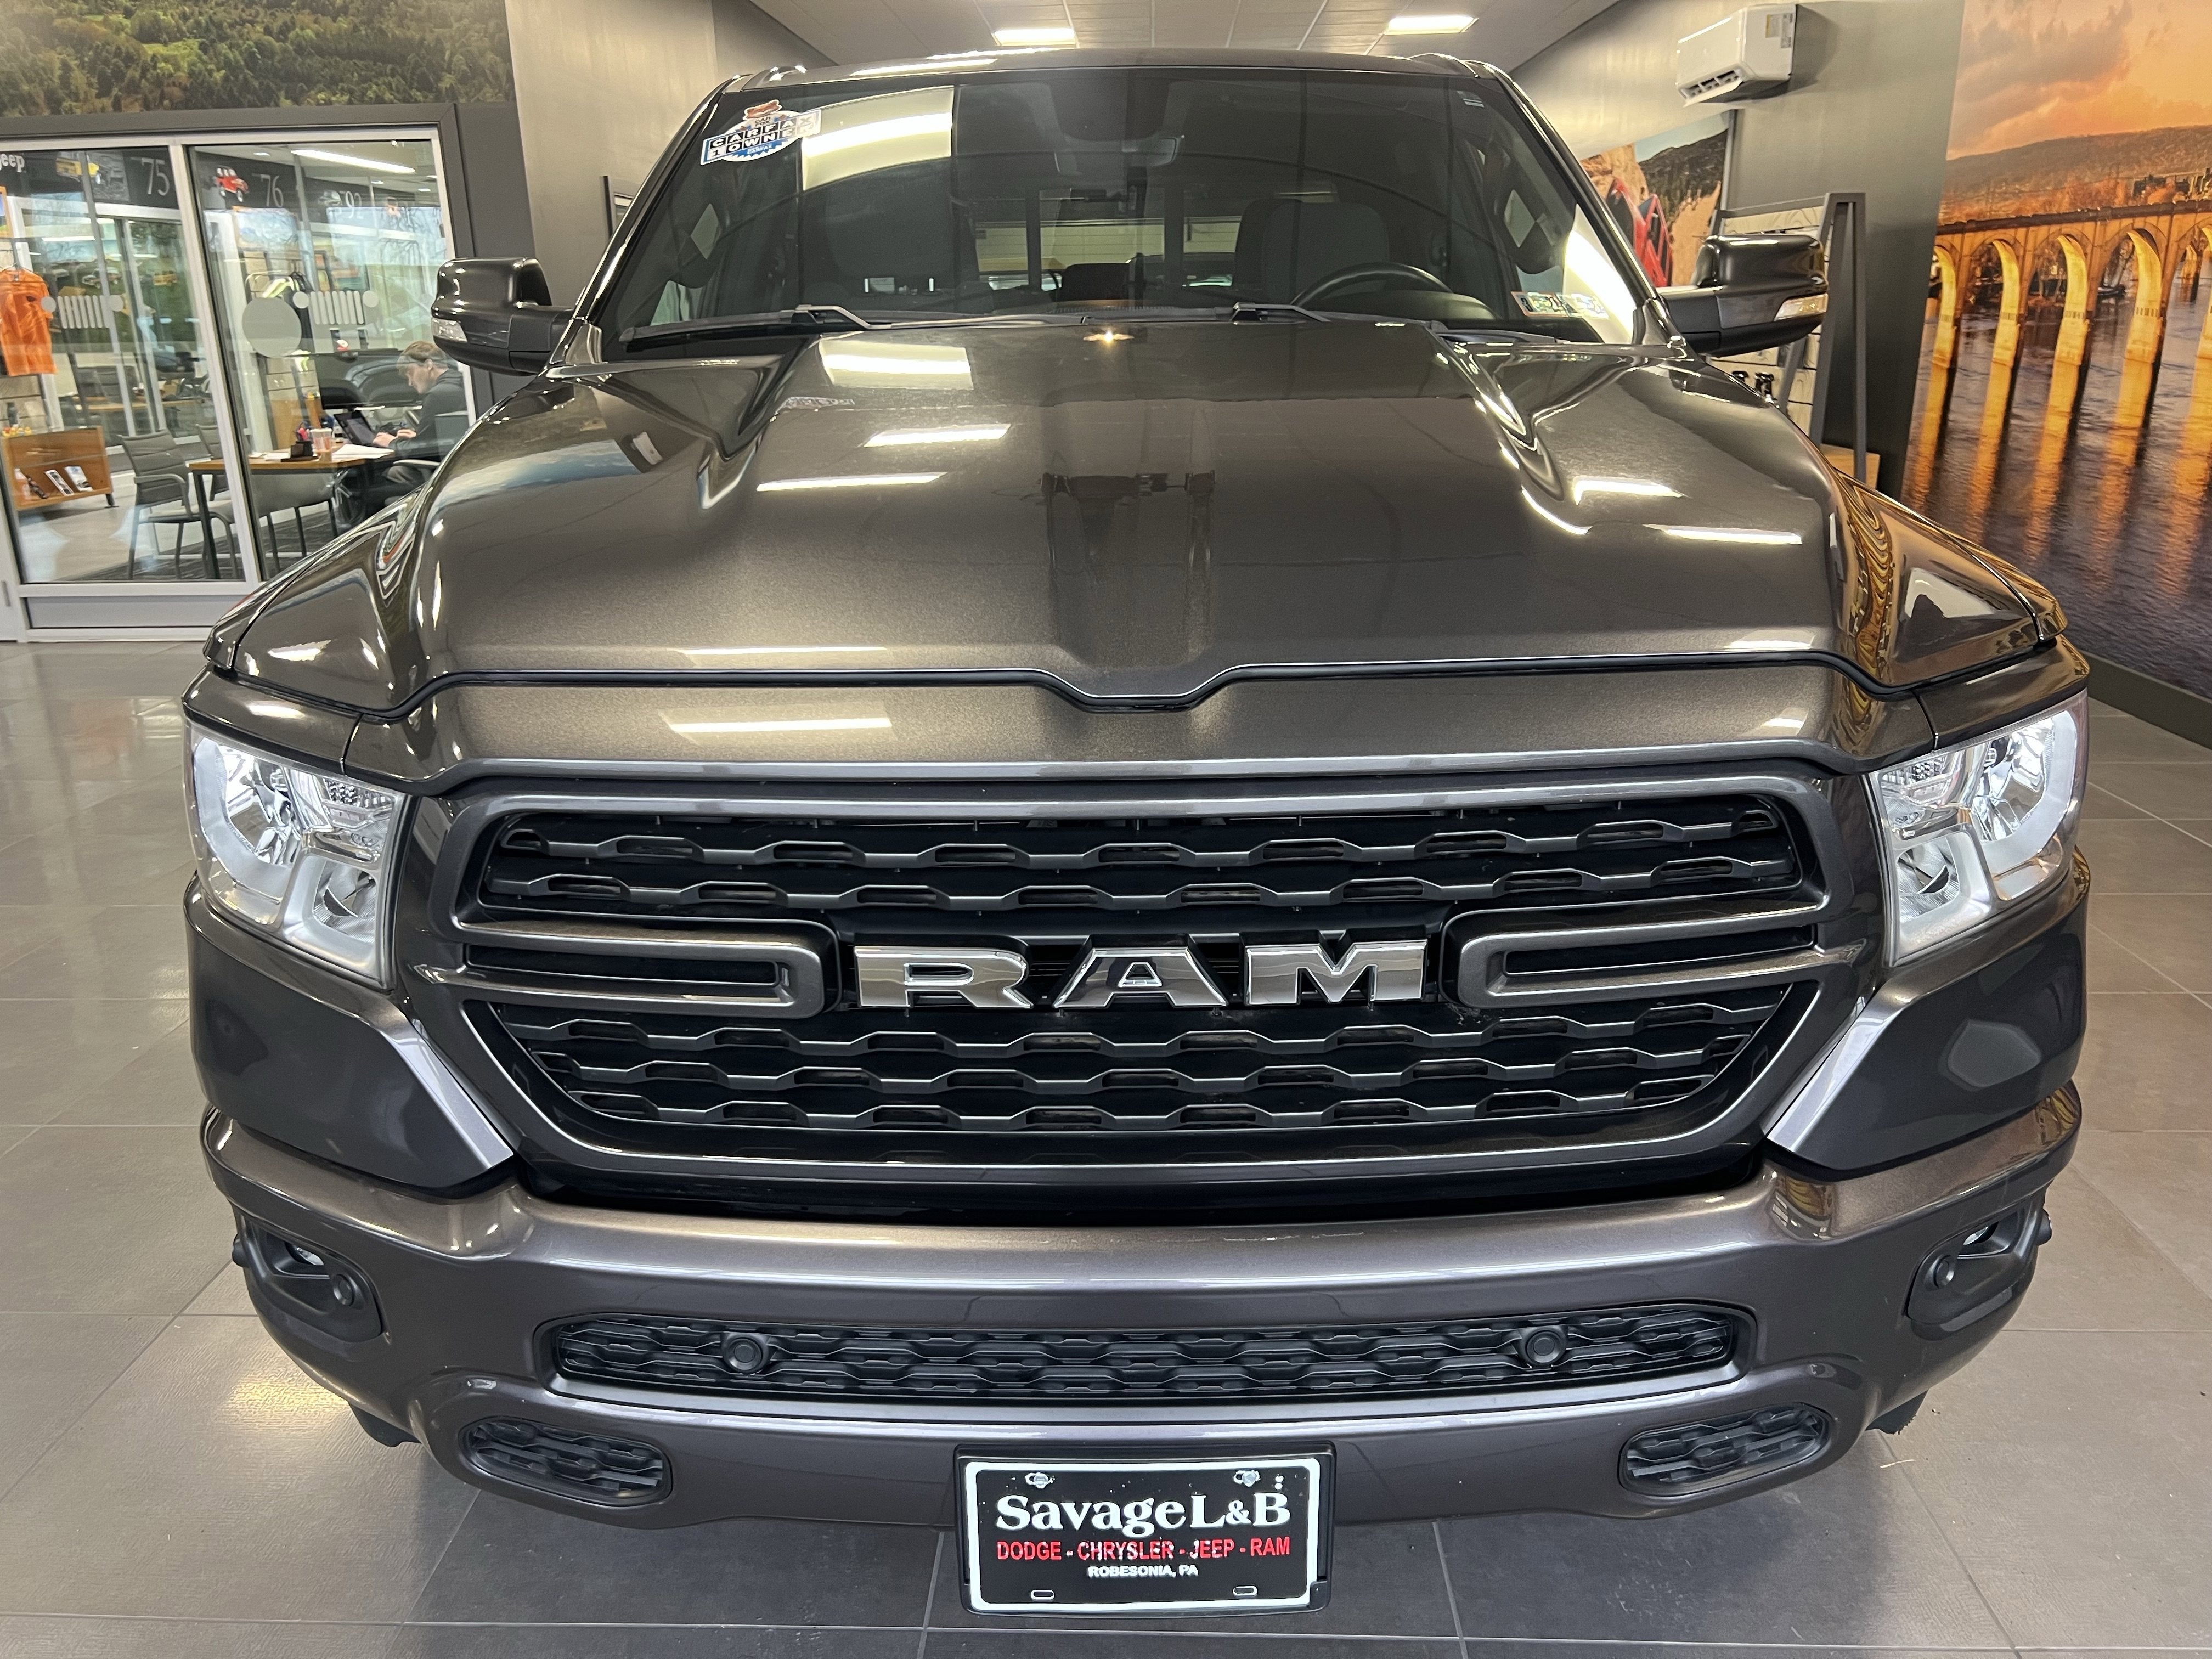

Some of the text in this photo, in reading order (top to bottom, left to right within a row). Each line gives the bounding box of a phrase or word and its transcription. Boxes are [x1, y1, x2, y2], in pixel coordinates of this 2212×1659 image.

[712, 116, 812, 148] CARFAX
[712, 149, 721, 157] 1
[727, 124, 815, 153] OWNER
[0, 153, 25, 173] eep
[854, 939, 1427, 1009] RAM
[997, 1541, 1062, 1560] DODGE
[1077, 1541, 1174, 1560] CHRYSLER
[1189, 1539, 1235, 1559] JEEP
[1250, 1536, 1290, 1557] RAM
[1088, 1564, 1199, 1578] ROBESONIA, PA
